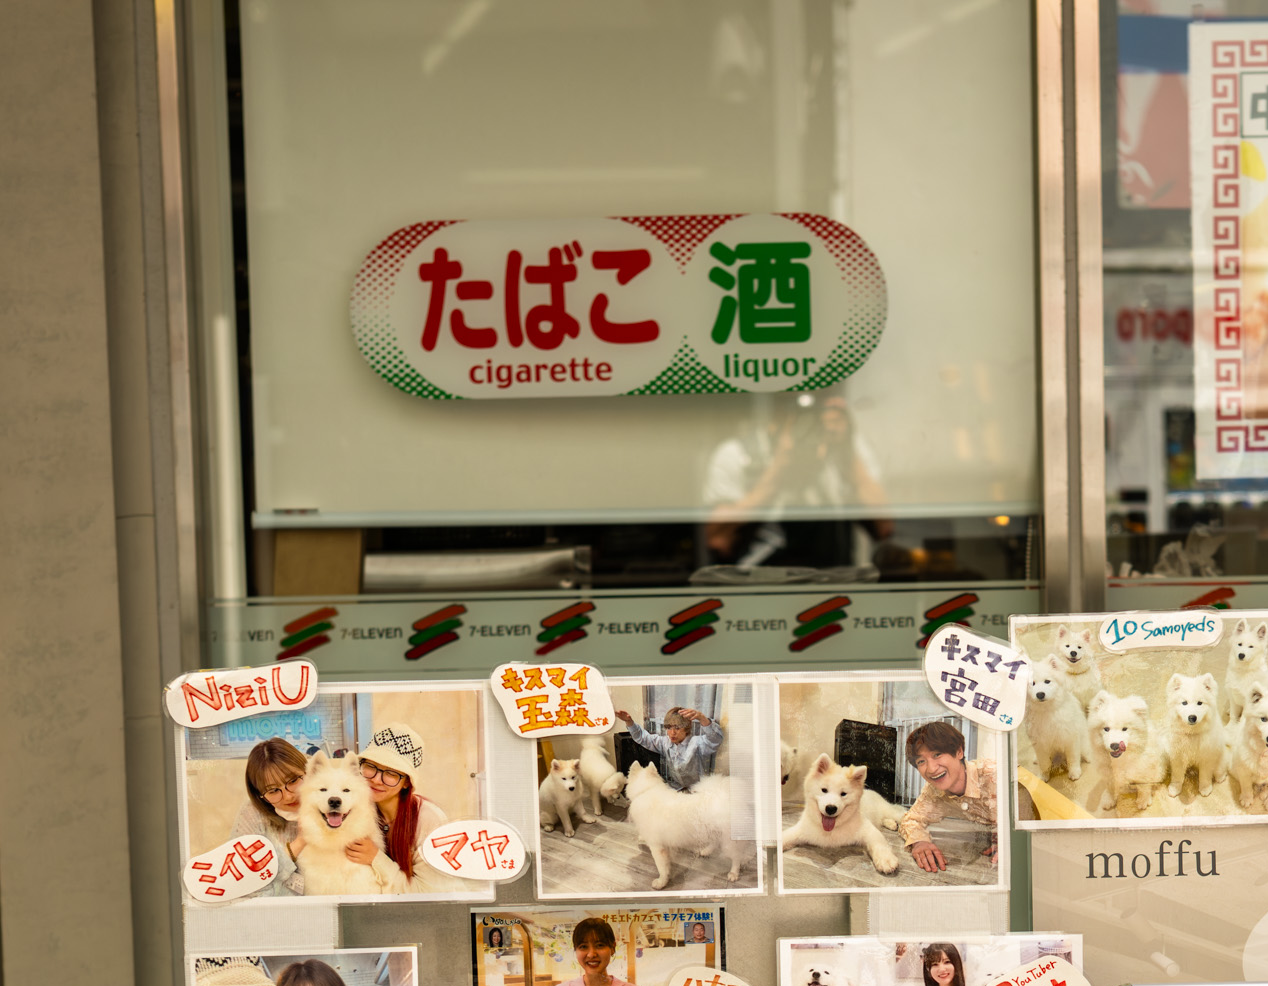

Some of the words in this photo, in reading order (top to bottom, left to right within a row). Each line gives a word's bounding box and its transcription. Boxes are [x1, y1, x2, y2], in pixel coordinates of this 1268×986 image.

[420, 240, 660, 351] たばこ
[708, 240, 812, 345] 酒
[468, 357, 613, 389] cigarette
[723, 352, 816, 382] liquor
[1106, 618, 1139, 645] 10
[1141, 616, 1215, 641] Samoyeds
[940, 633, 1029, 681] キスマイ
[180, 665, 310, 723] NiziU
[500, 666, 590, 693] キスマイ
[1085, 839, 1221, 879] moffu
